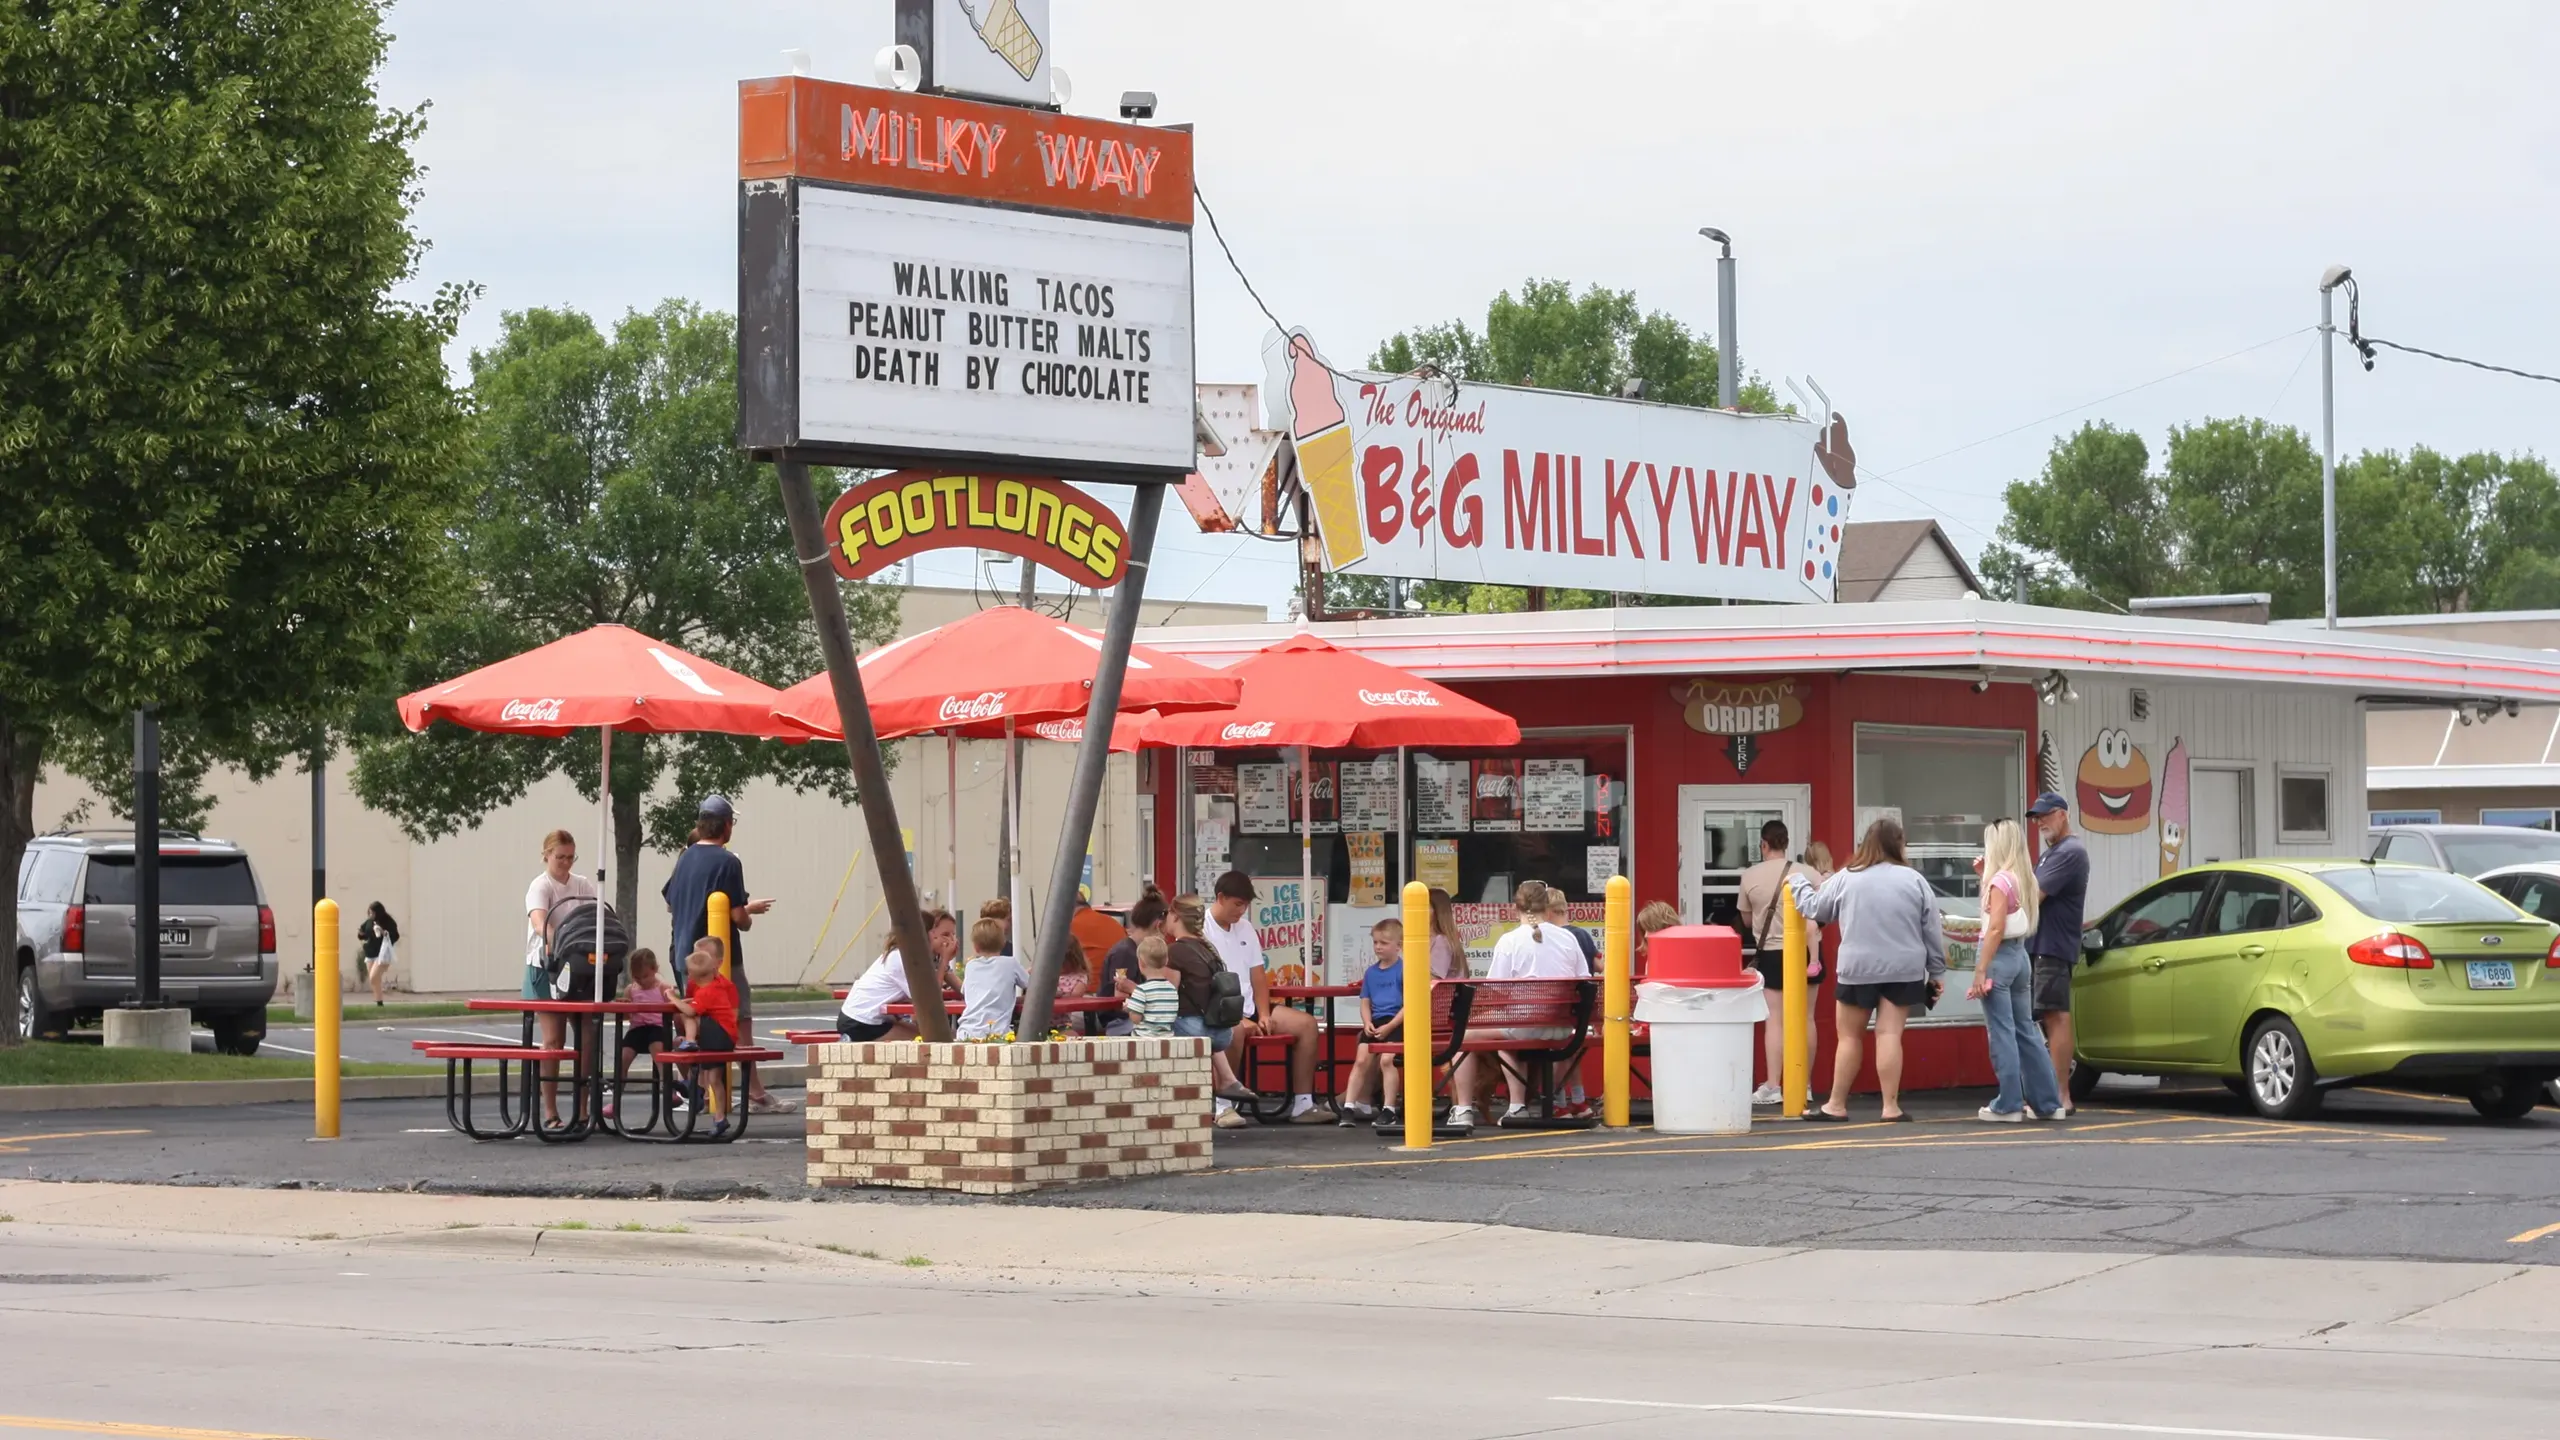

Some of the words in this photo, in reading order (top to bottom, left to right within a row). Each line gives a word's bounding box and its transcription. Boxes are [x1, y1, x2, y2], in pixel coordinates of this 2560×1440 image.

[841, 103, 1006, 178] MILKY
[1036, 131, 1161, 198] WAY
[894, 261, 1008, 307] WALKING
[1036, 277, 1114, 319] TACOS
[849, 302, 946, 342] PEANUT
[969, 311, 1058, 354] BUTTER
[1078, 324, 1151, 362] MALTS
[856, 345, 938, 386] DEATH
[966, 356, 1000, 391] BY
[1022, 361, 1149, 403] CHOCOLATE
[1359, 383, 1395, 428] The
[1405, 388, 1485, 444] Original
[1361, 436, 1484, 549] B&G
[1502, 448, 1797, 570] MILKYWAY
[838, 475, 1122, 579] FOOTLONGS
[501, 698, 566, 721] Coca-Cola
[939, 692, 1007, 721] Coca-Cola
[1358, 688, 1440, 707] Coca-Cola
[1221, 721, 1276, 740] Coca-Cola
[1703, 703, 1780, 733] ORDER
[1188, 751, 1214, 765] 2410
[1737, 736, 1748, 770] HERE
[1596, 773, 1611, 837] OPEN
[1419, 844, 1455, 855] THANKS
[1273, 883, 1300, 904] ICE
[1455, 906, 1478, 925] B&G
